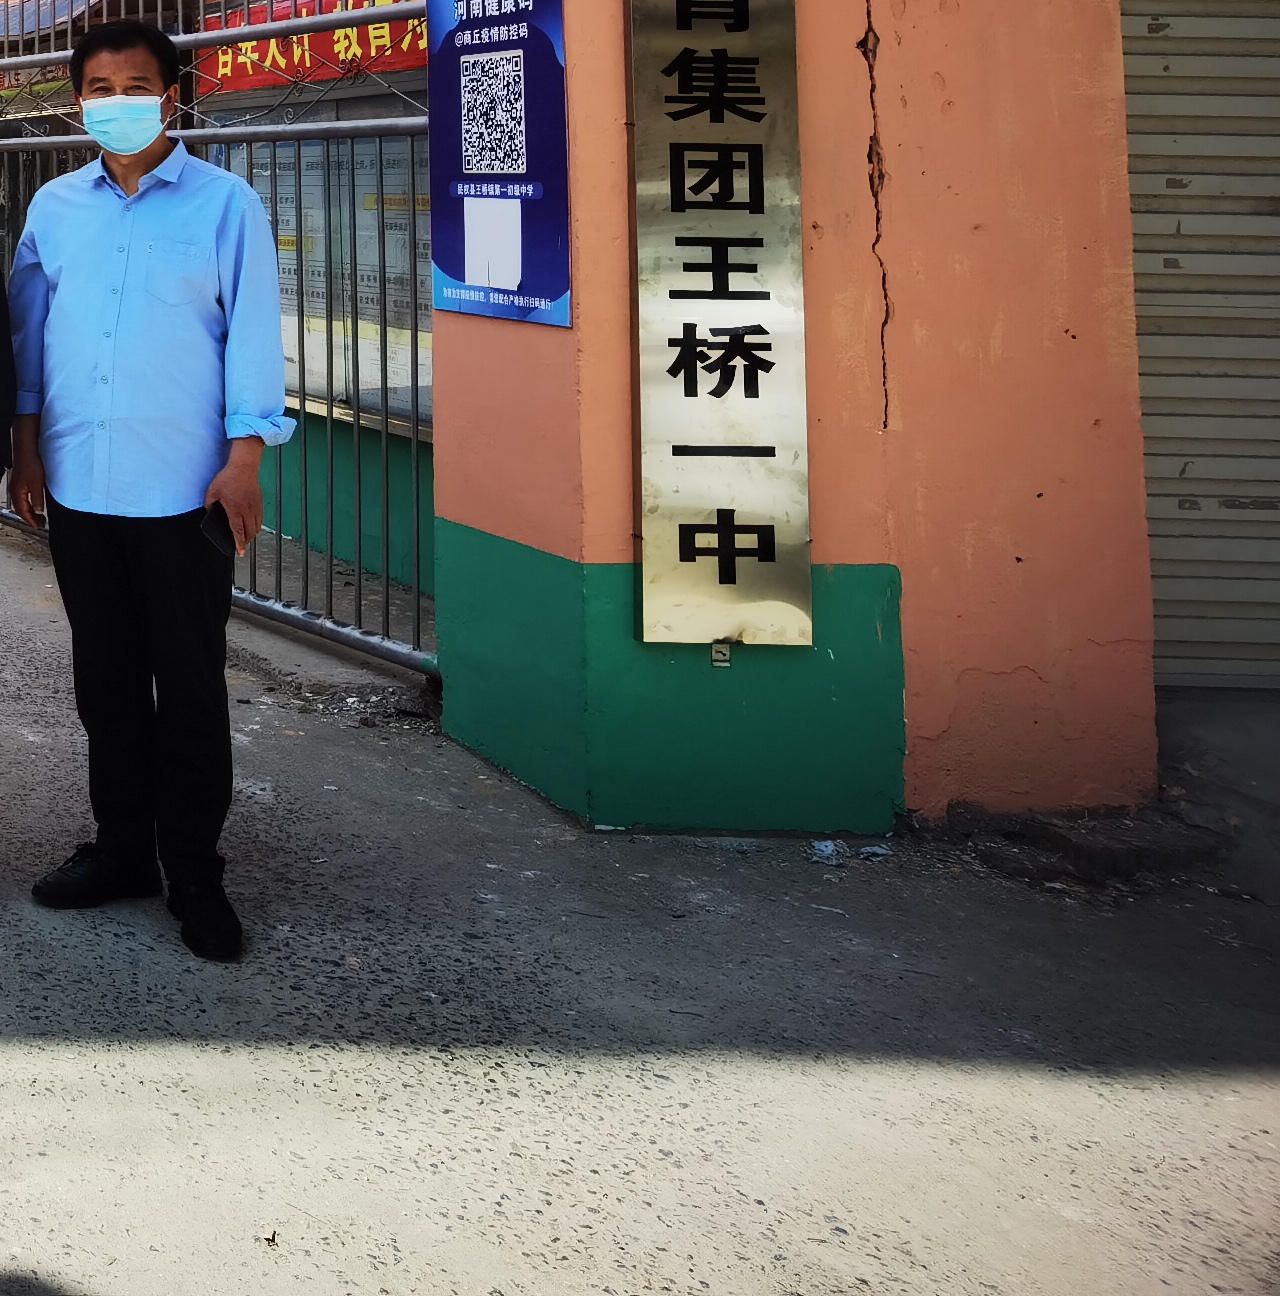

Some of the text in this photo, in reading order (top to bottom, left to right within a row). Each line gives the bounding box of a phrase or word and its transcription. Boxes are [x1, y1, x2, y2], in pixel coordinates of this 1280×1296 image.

[455, 23, 529, 47] @商丘疫情防控码
